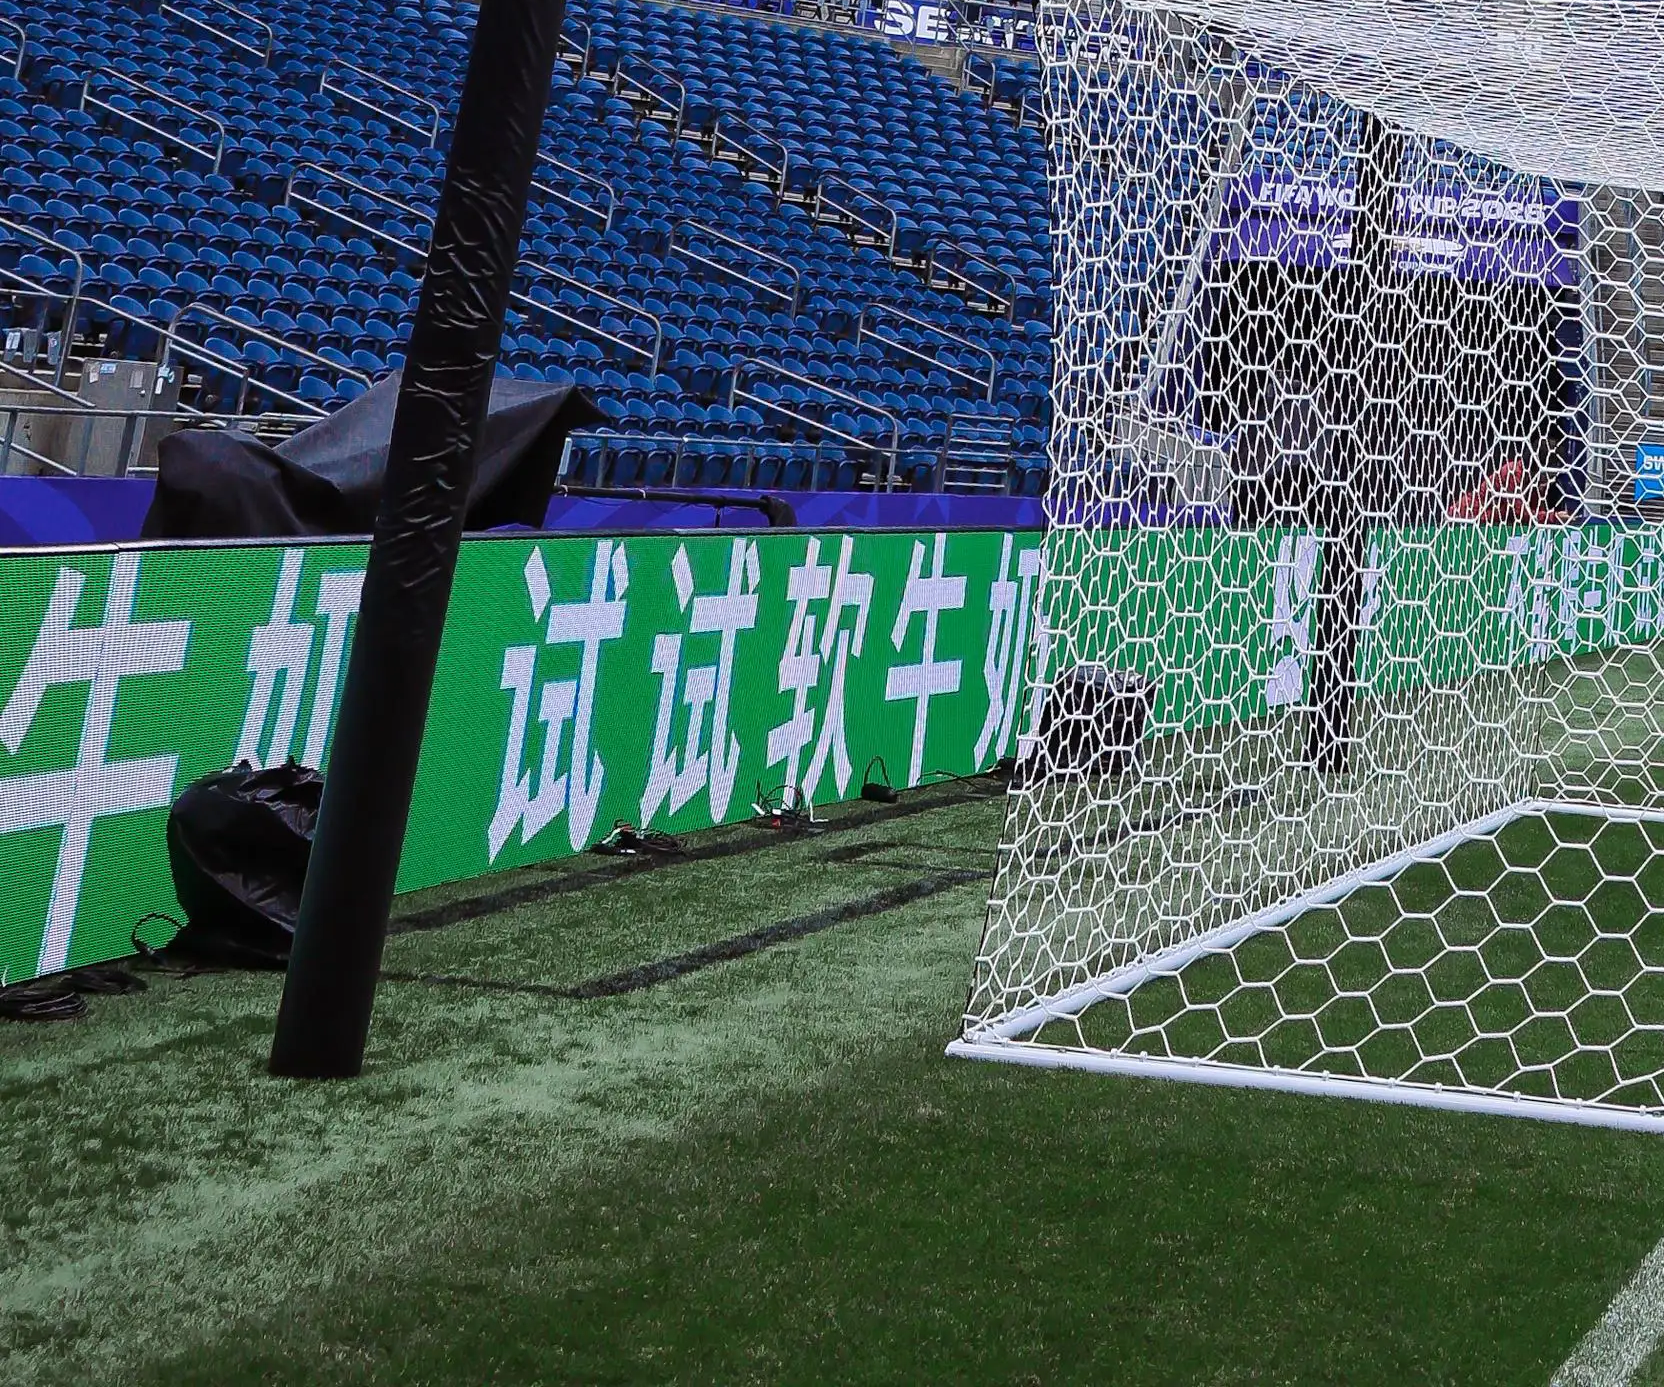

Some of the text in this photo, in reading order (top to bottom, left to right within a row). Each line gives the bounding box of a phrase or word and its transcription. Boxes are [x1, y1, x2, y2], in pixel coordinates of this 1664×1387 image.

[1261, 183, 1311, 206] FIFA
[487, 533, 1050, 865] 试试软牛奶
